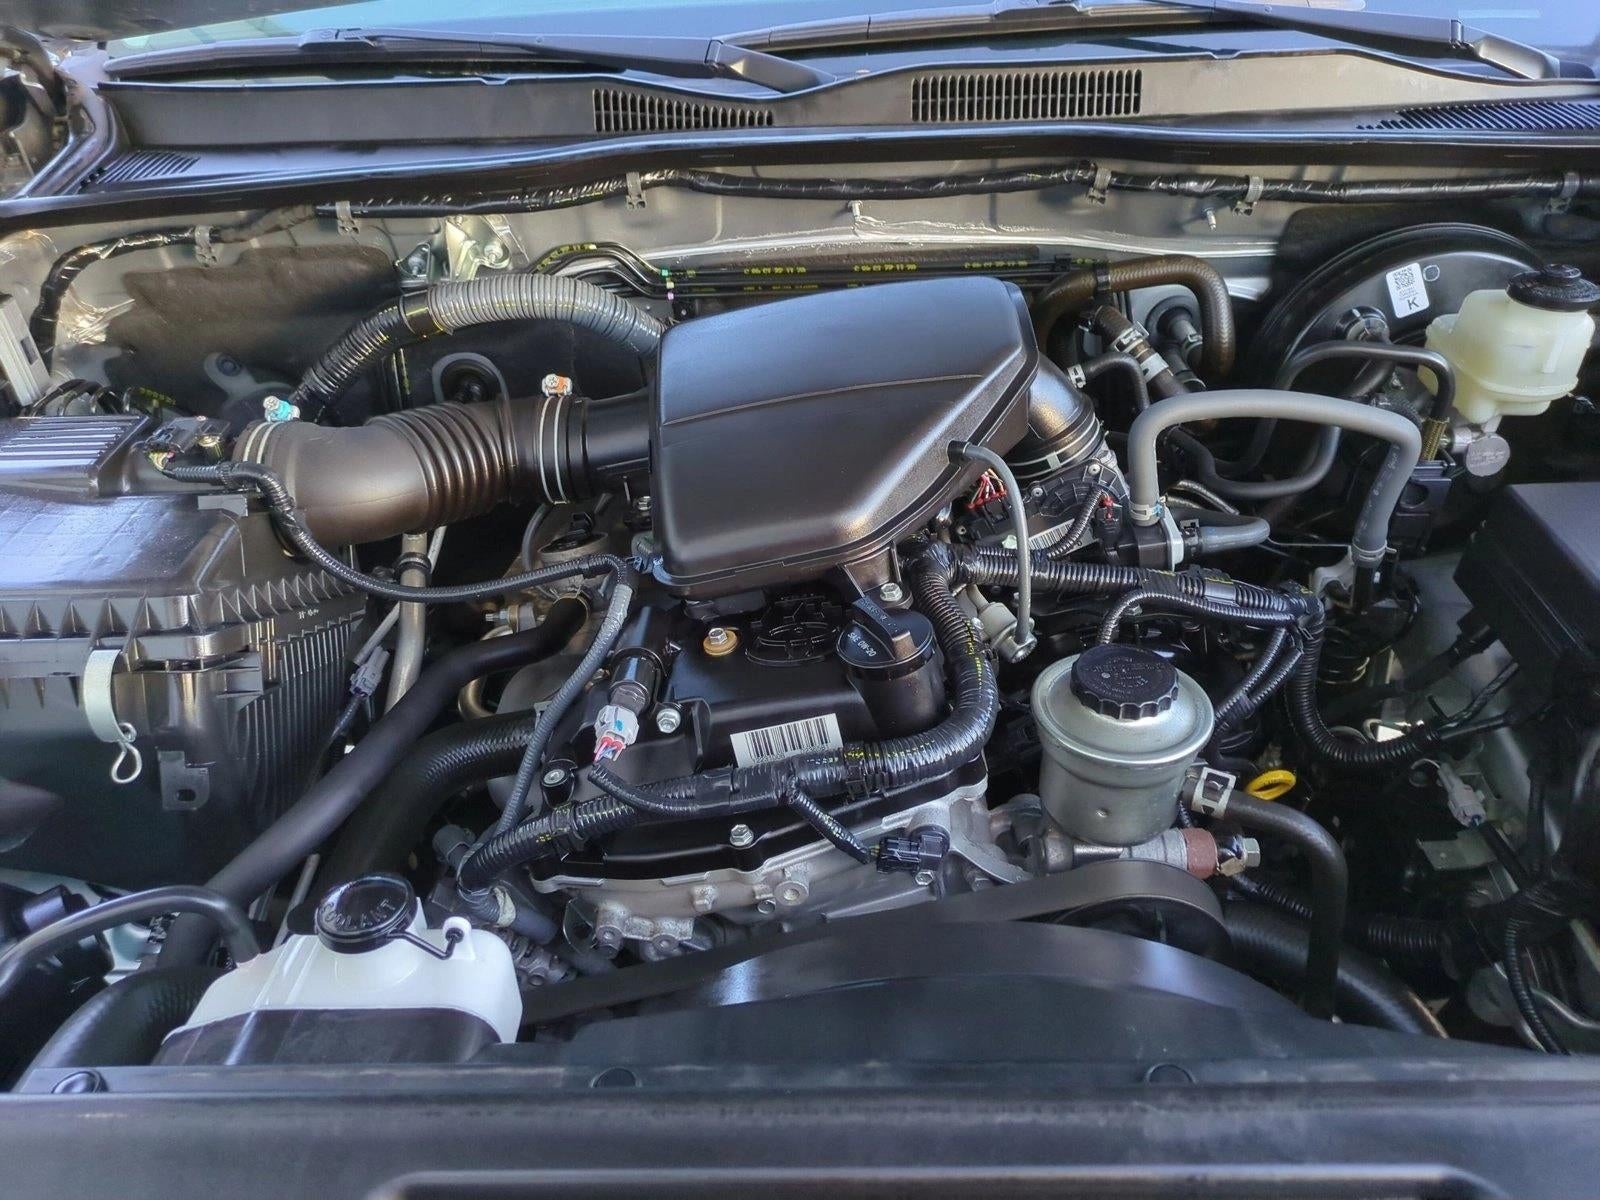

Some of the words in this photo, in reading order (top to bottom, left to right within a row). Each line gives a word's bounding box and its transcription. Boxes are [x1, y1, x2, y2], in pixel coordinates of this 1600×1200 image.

[1407, 296, 1420, 310] K
[847, 631, 861, 643] SAE
[857, 640, 877, 657] 0W-20
